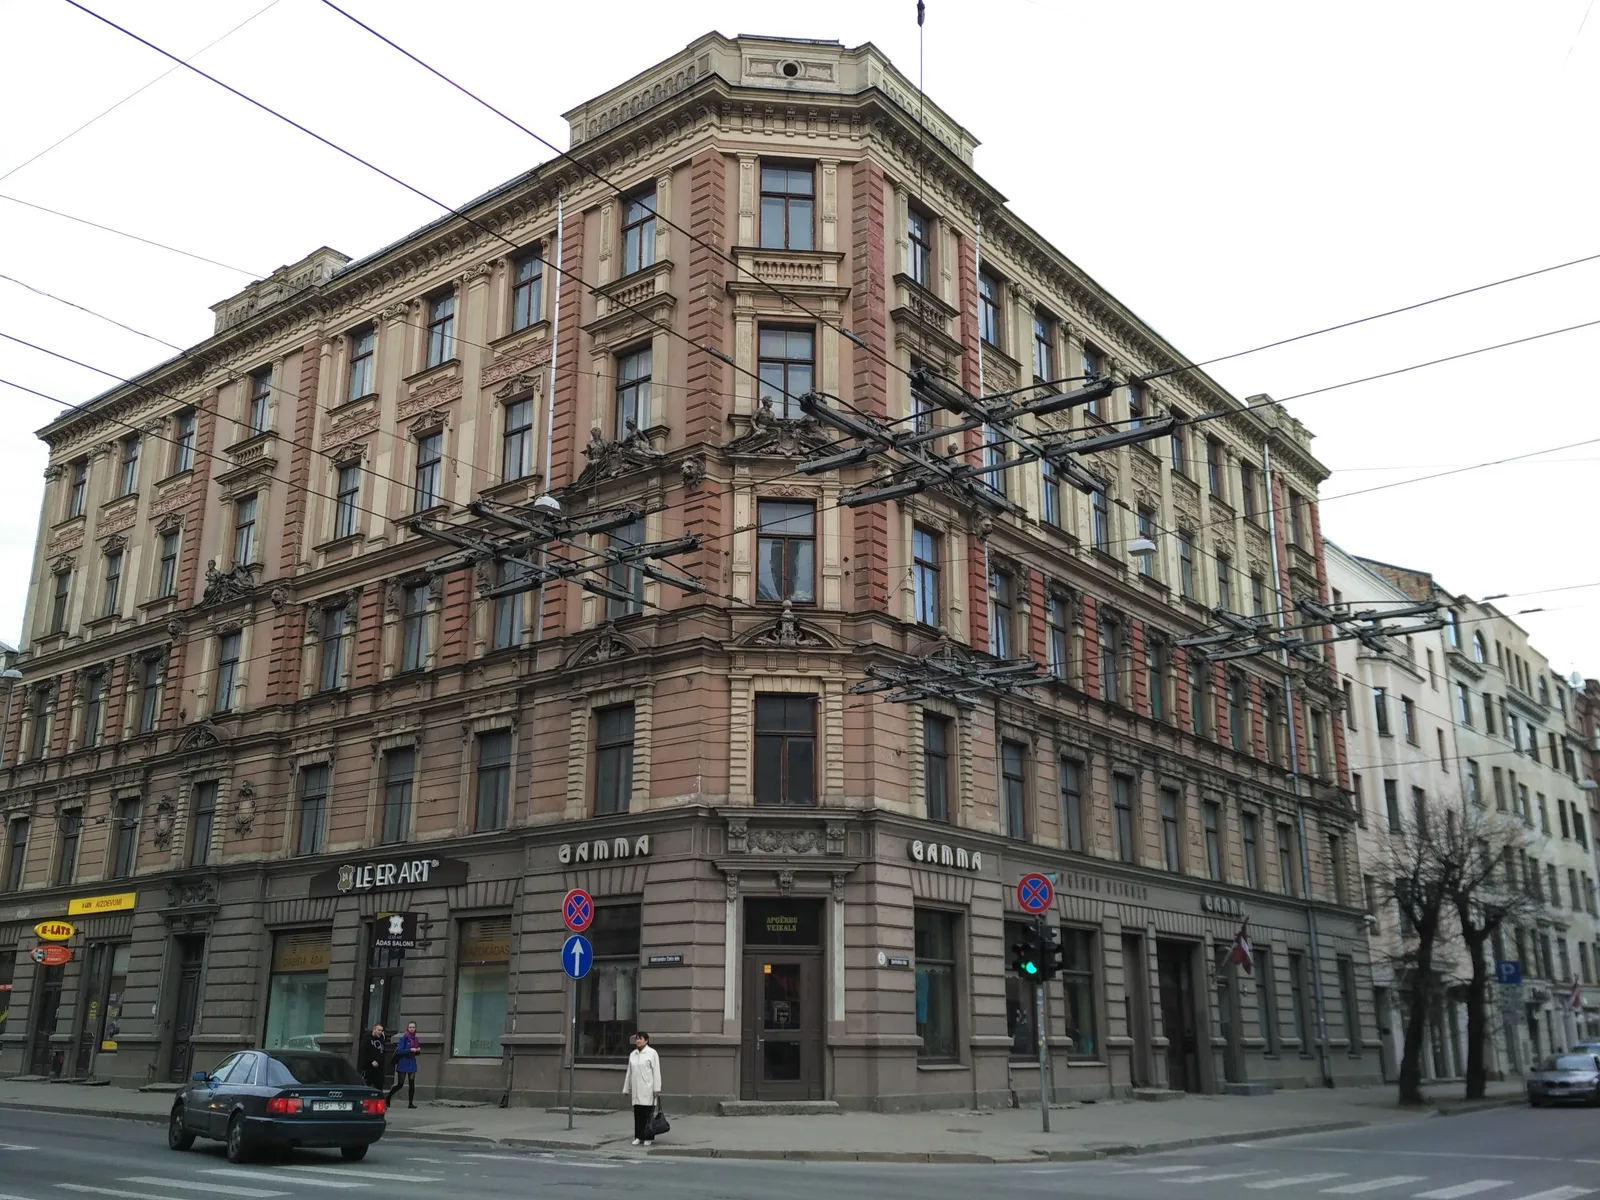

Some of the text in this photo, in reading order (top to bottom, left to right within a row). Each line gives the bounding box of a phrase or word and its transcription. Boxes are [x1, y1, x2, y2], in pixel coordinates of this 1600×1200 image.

[558, 834, 649, 863] GAMMA
[912, 840, 982, 870] GAMMA
[41, 925, 70, 935] E-LATS
[1501, 963, 1515, 981] P
